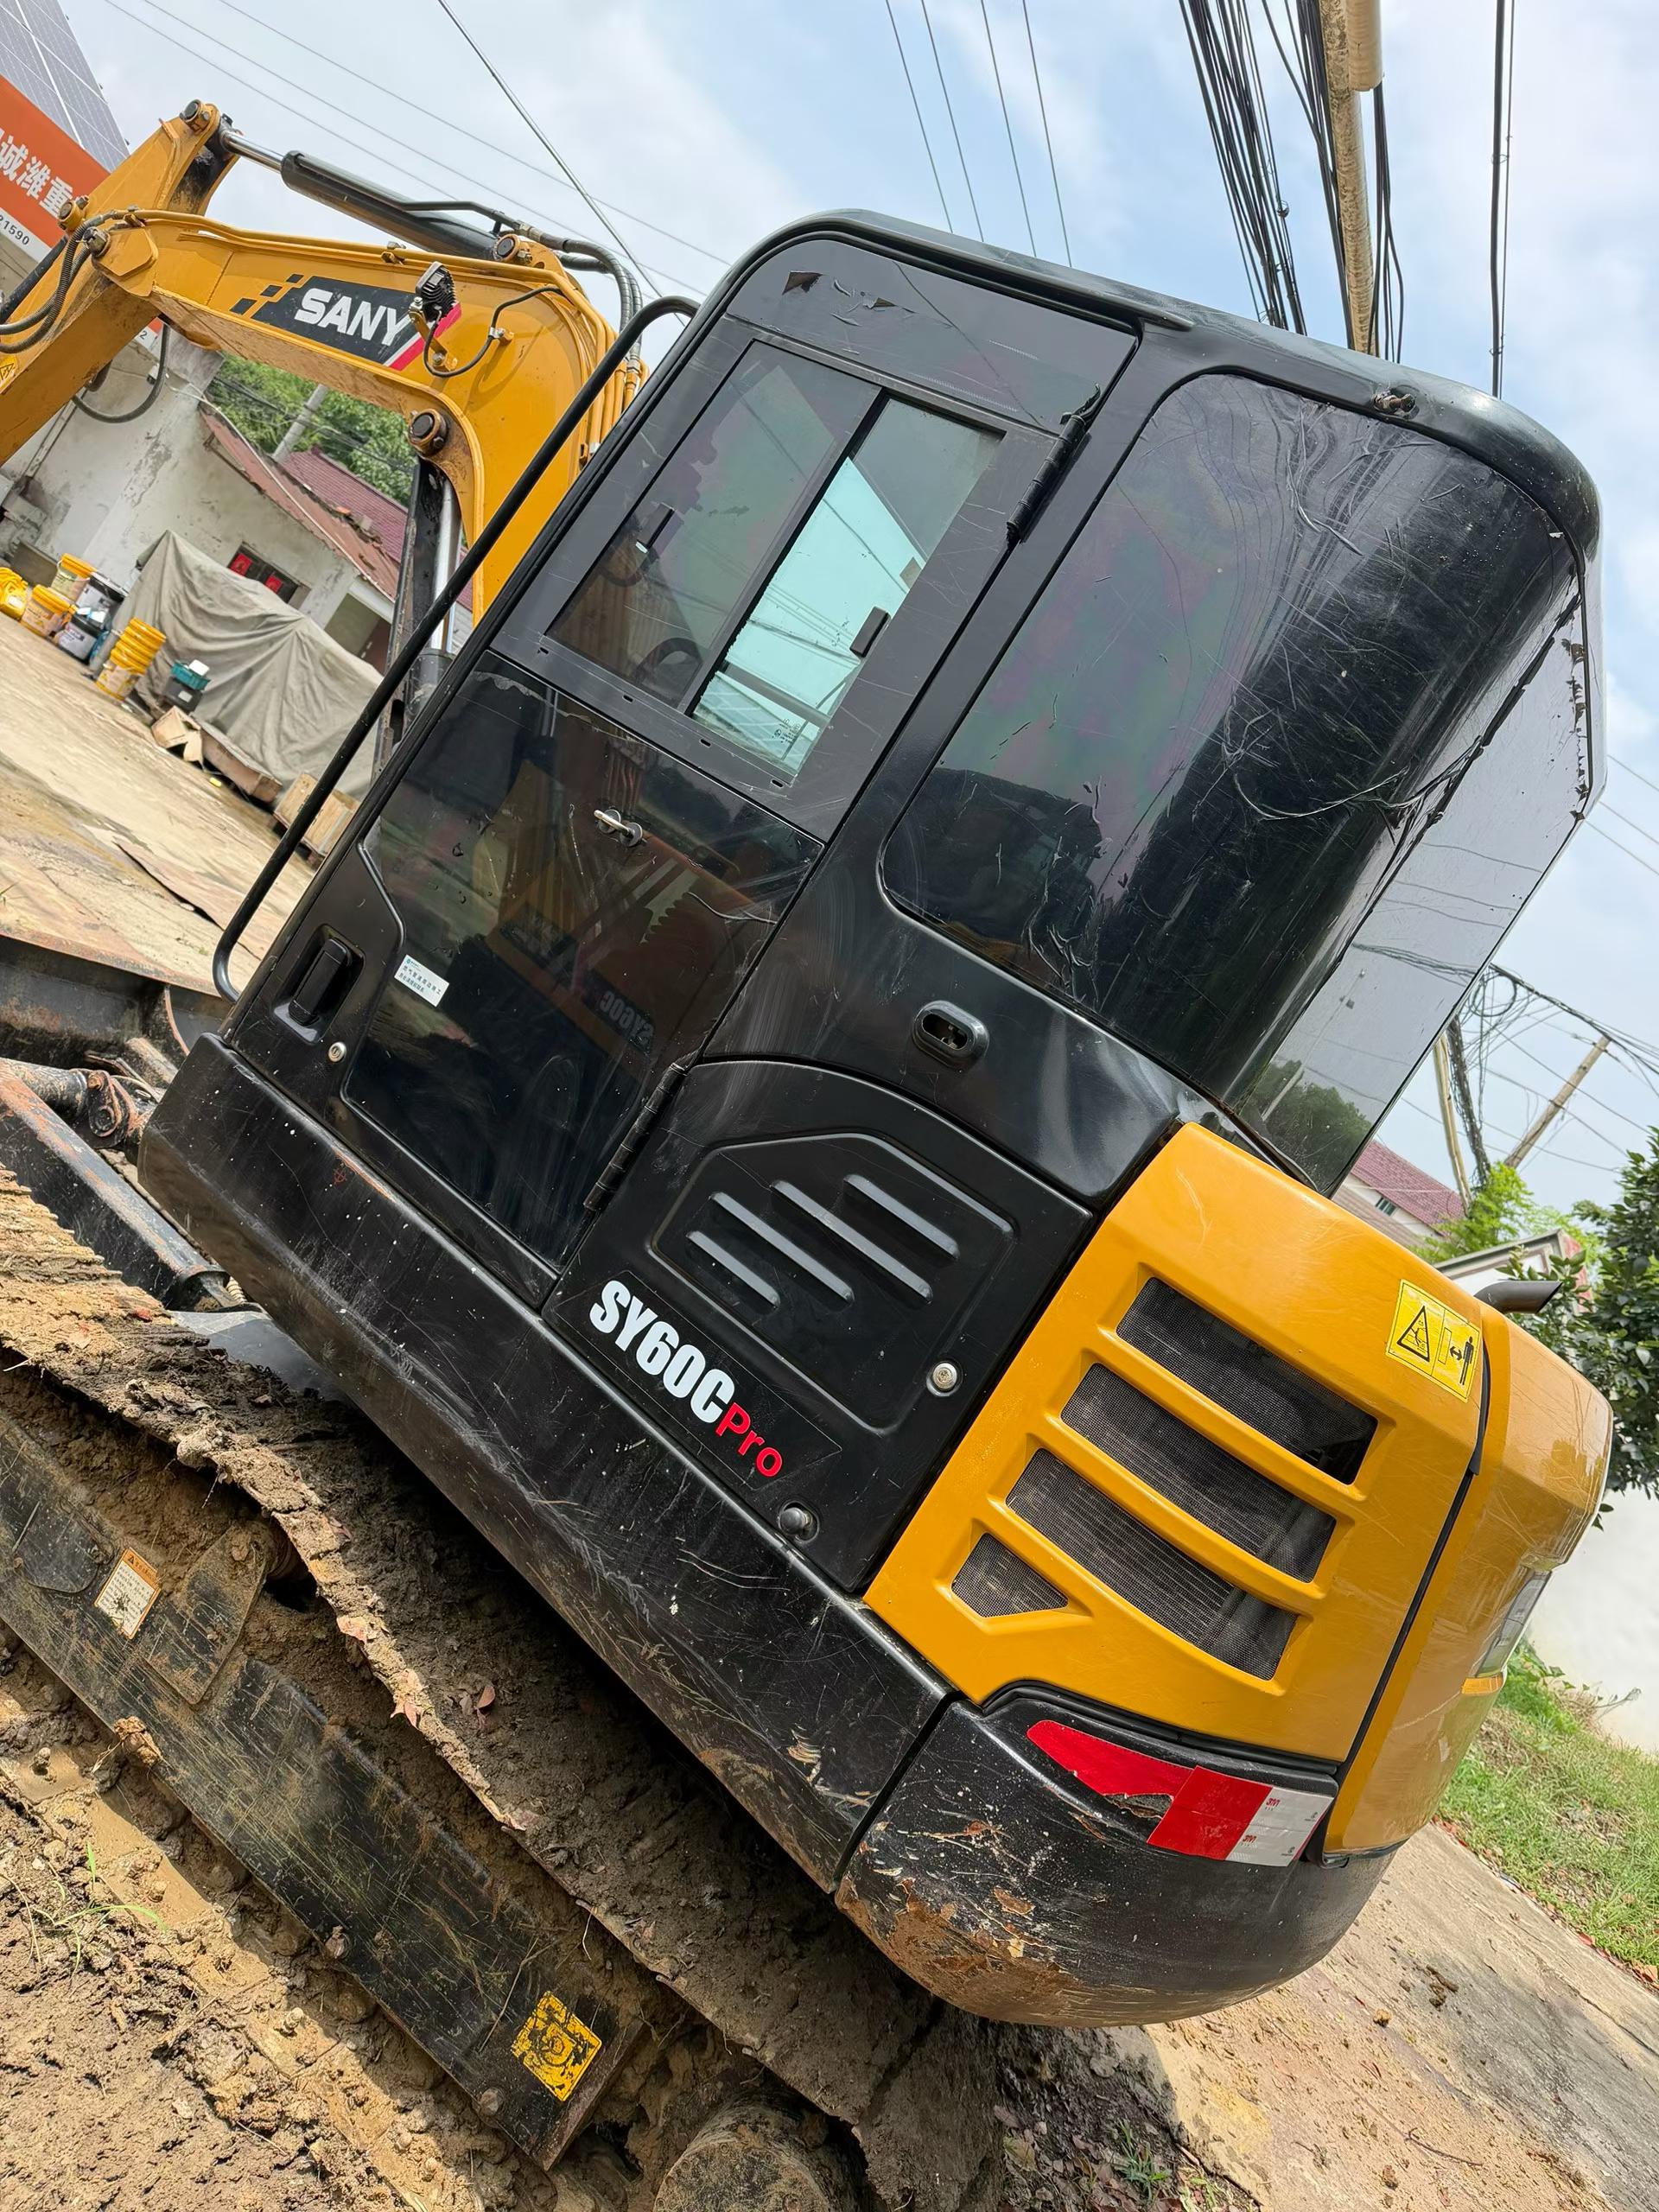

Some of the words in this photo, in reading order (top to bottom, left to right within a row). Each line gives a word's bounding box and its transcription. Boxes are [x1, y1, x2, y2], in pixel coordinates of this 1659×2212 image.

[0, 128, 73, 219] 诚潍重
[295, 288, 413, 346] SANY
[589, 1280, 735, 1423] SY60C
[715, 1402, 783, 1478] Pro
